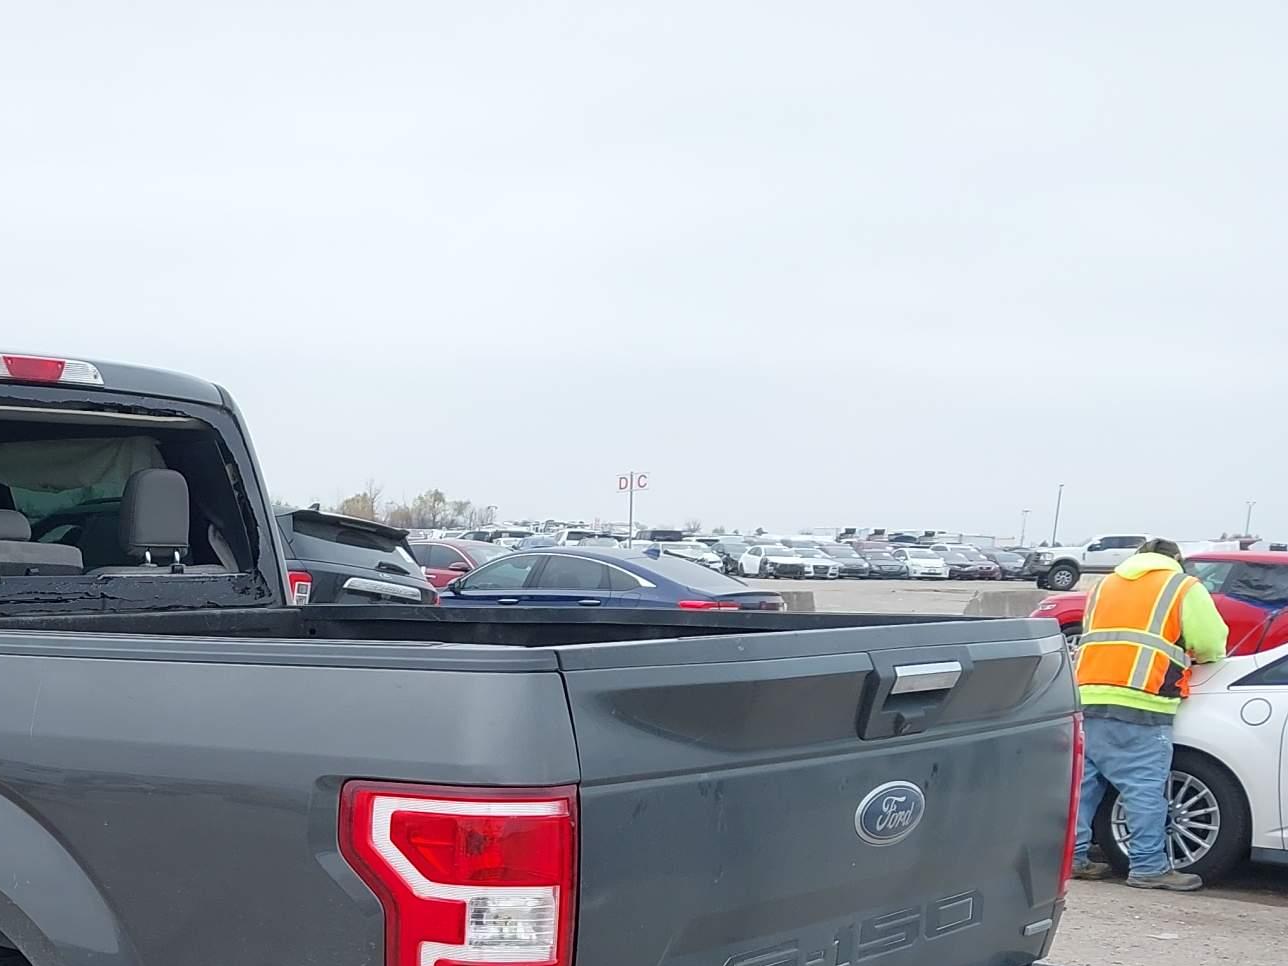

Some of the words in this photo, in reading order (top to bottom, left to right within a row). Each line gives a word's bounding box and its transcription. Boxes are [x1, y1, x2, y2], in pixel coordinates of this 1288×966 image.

[619, 476, 629, 490] D
[637, 474, 648, 489] C
[876, 795, 915, 831] Ford
